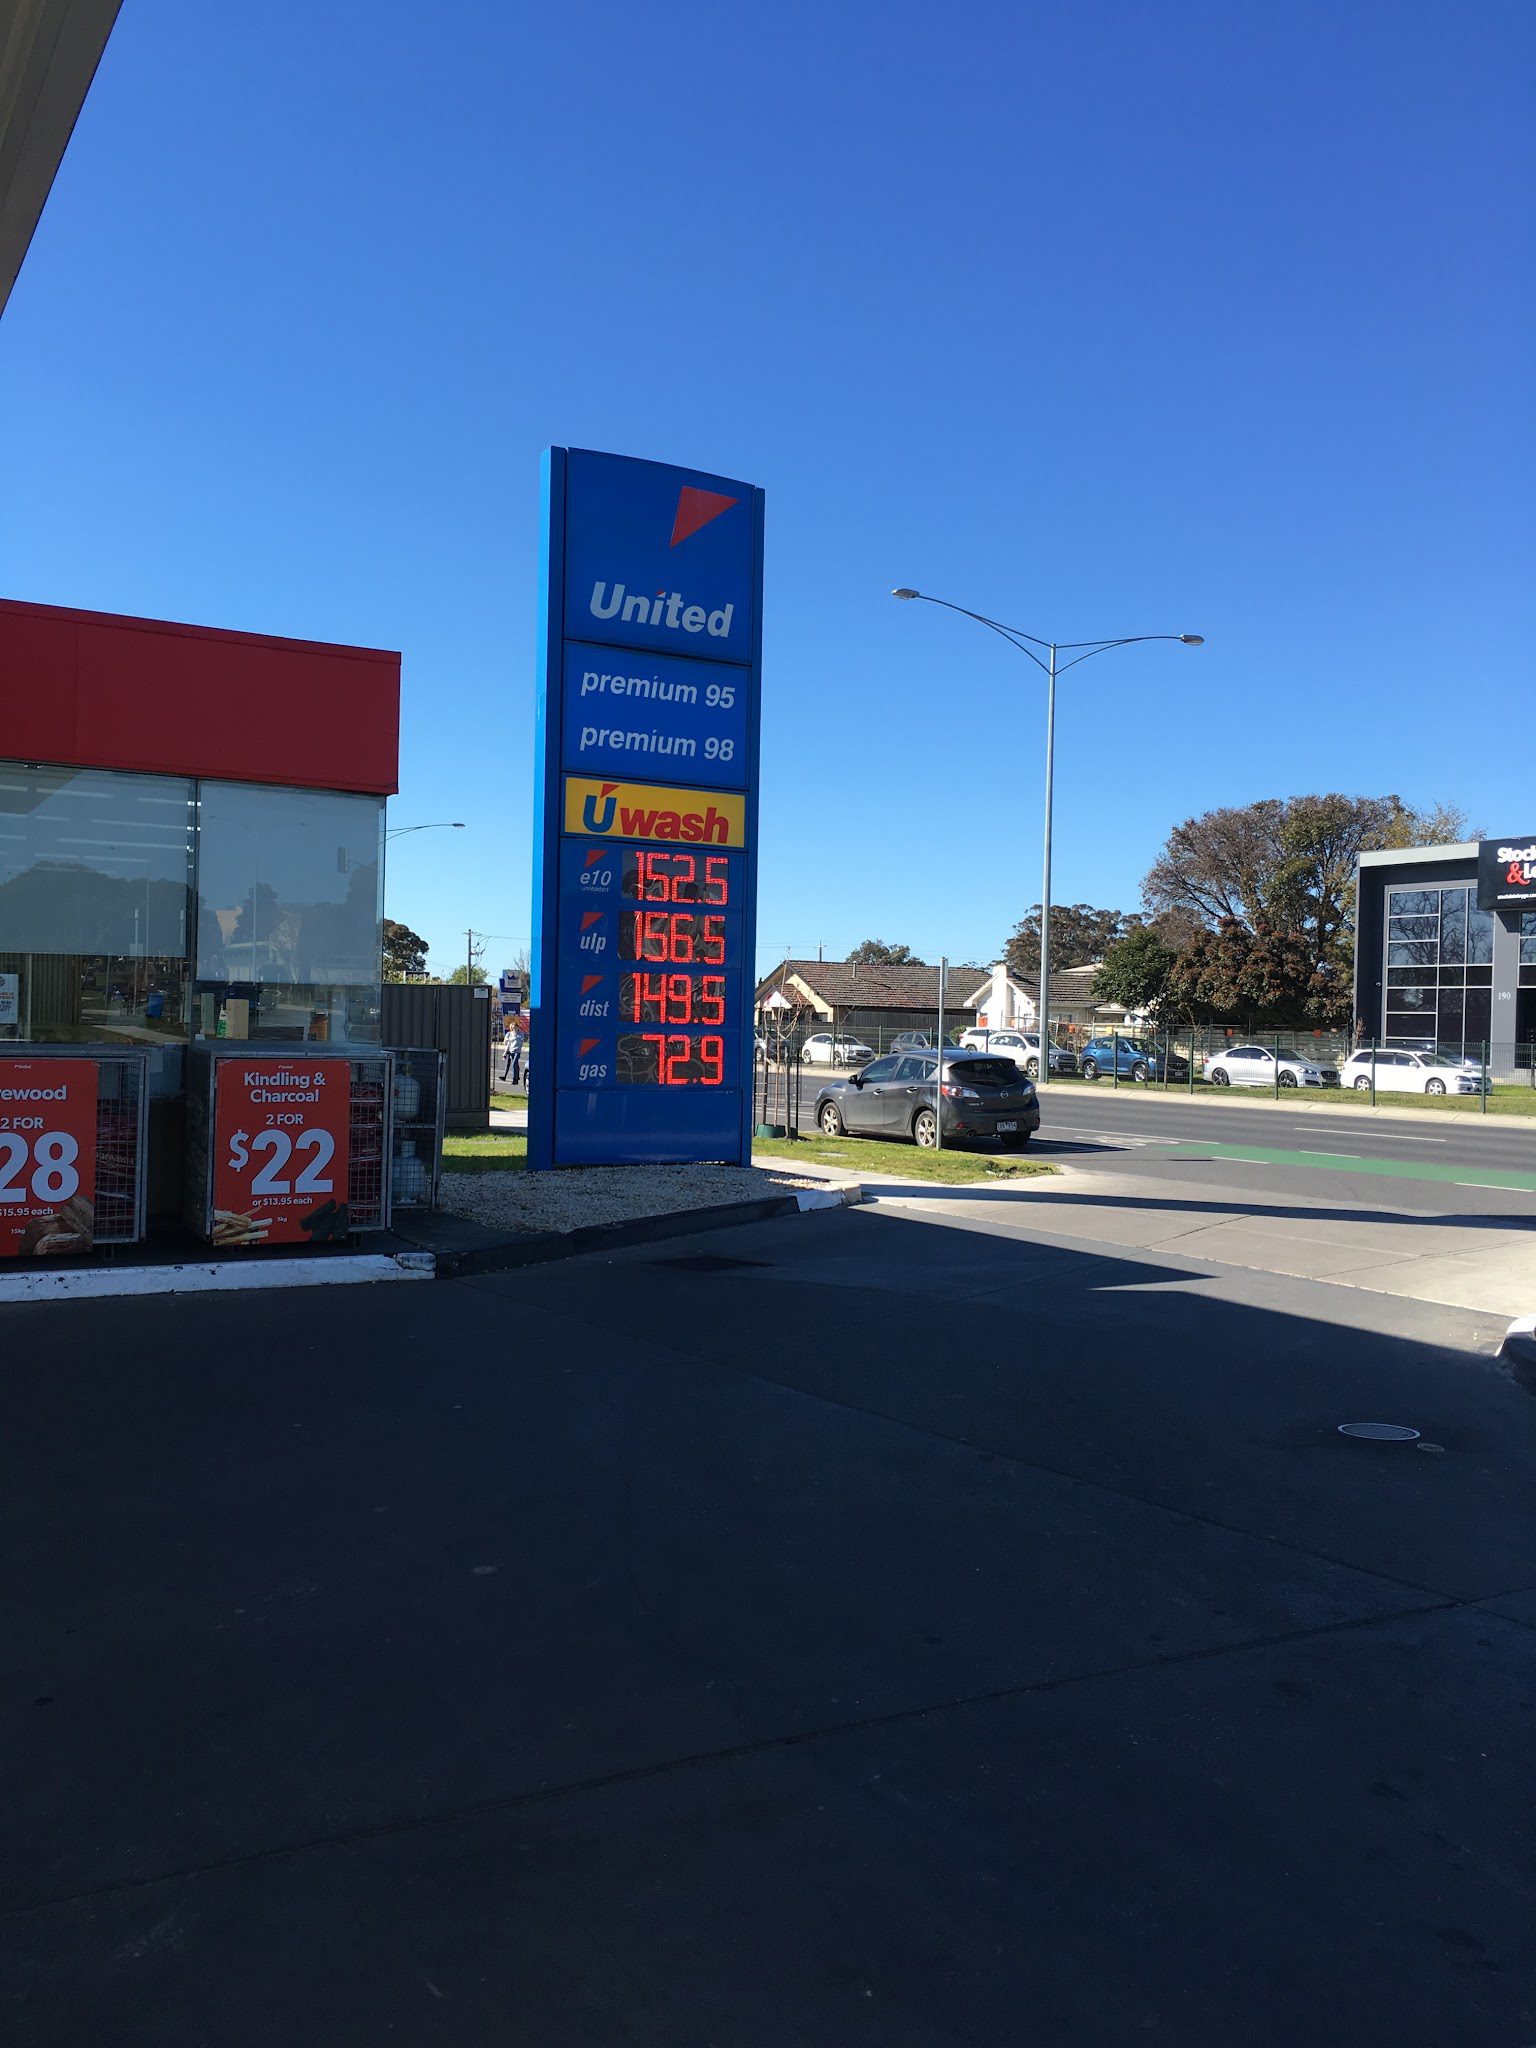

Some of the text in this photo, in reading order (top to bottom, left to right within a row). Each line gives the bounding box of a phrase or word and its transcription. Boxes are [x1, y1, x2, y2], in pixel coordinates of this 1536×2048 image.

[589, 581, 735, 638] United
[580, 672, 736, 710] premium 95
[580, 726, 735, 762] premium 98
[579, 851, 729, 906] e10 152.5
[579, 910, 726, 965] ulp 156.5
[579, 972, 725, 1025] dist 149.5
[1497, 991, 1512, 1000] 190
[578, 1034, 724, 1085] gas 72.9
[0, 1085, 67, 1101] ewood
[243, 1072, 327, 1089] Kindling &
[249, 1089, 319, 1103] Charcoal
[0, 1117, 44, 1129] 2 FOR
[265, 1113, 304, 1125] 2 FOR
[227, 1128, 336, 1196] $22
[31, 1207, 54, 1216] each
[252, 1196, 313, 1207] or $13.95 each
